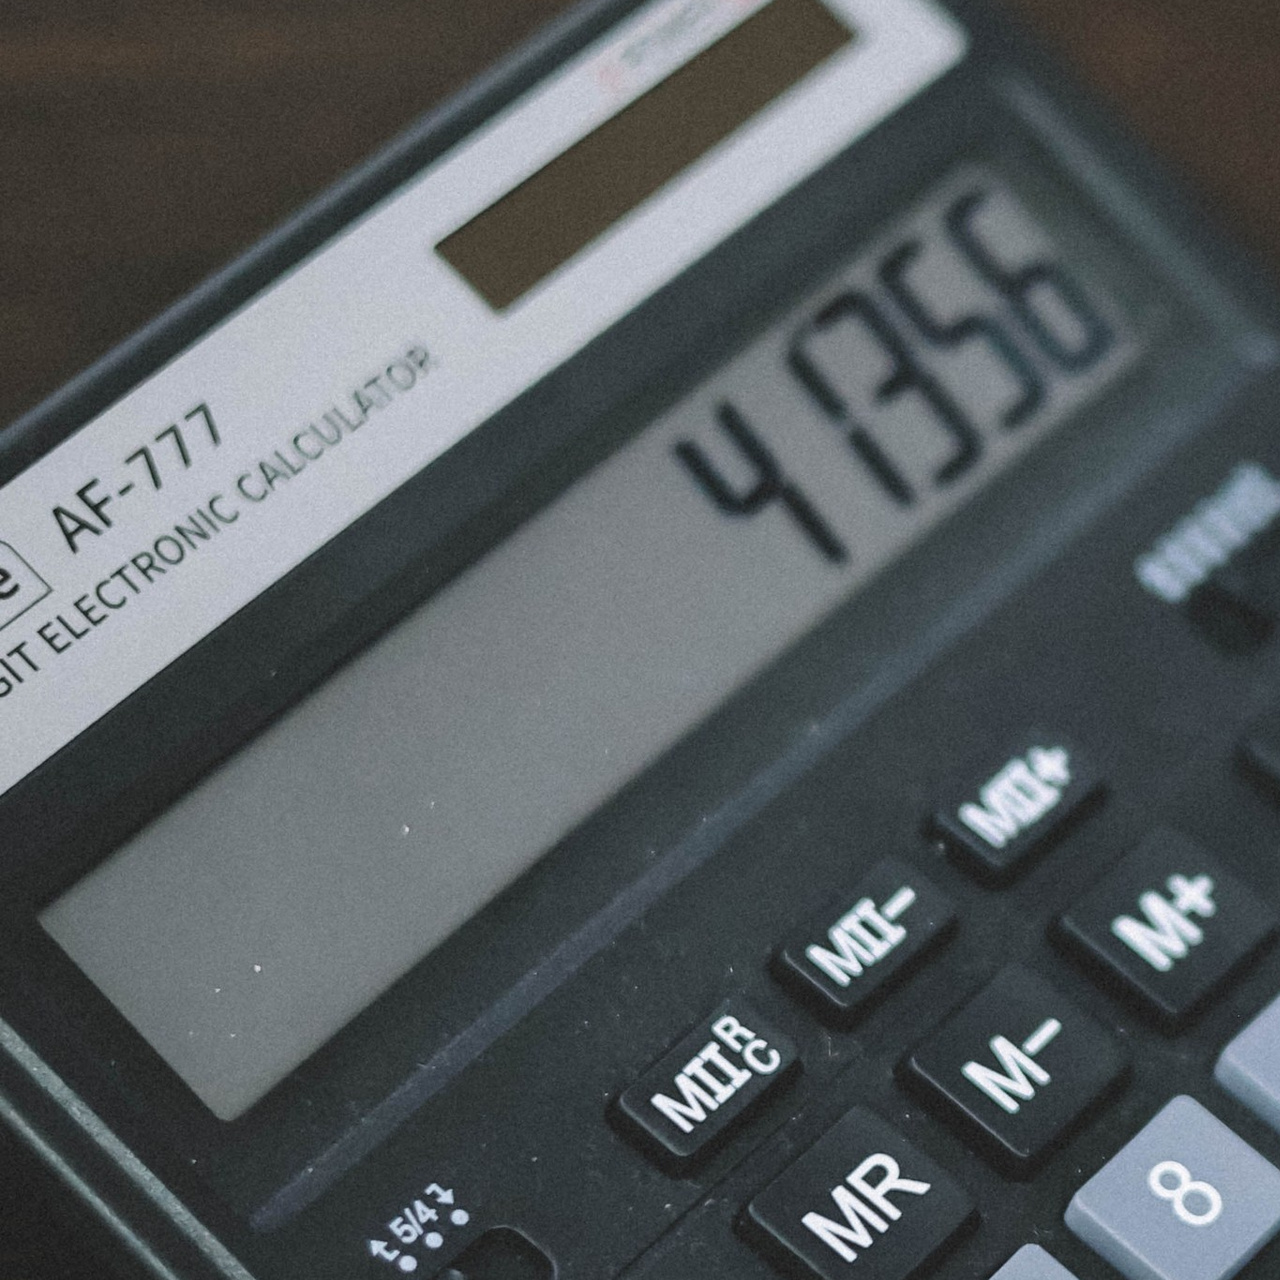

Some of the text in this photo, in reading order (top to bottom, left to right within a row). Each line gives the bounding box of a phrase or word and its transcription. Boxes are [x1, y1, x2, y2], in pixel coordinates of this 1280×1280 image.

[671, 188, 1114, 565] 41356
[36, 493, 241, 655] ELECTRONIC
[236, 344, 439, 504] CALCULATOR
[51, 401, 223, 554] AF-777
[1113, 875, 1215, 971] M+
[961, 1017, 1062, 1114] M-
[800, 1152, 932, 1264] MR
[1147, 1159, 1224, 1227] 8
